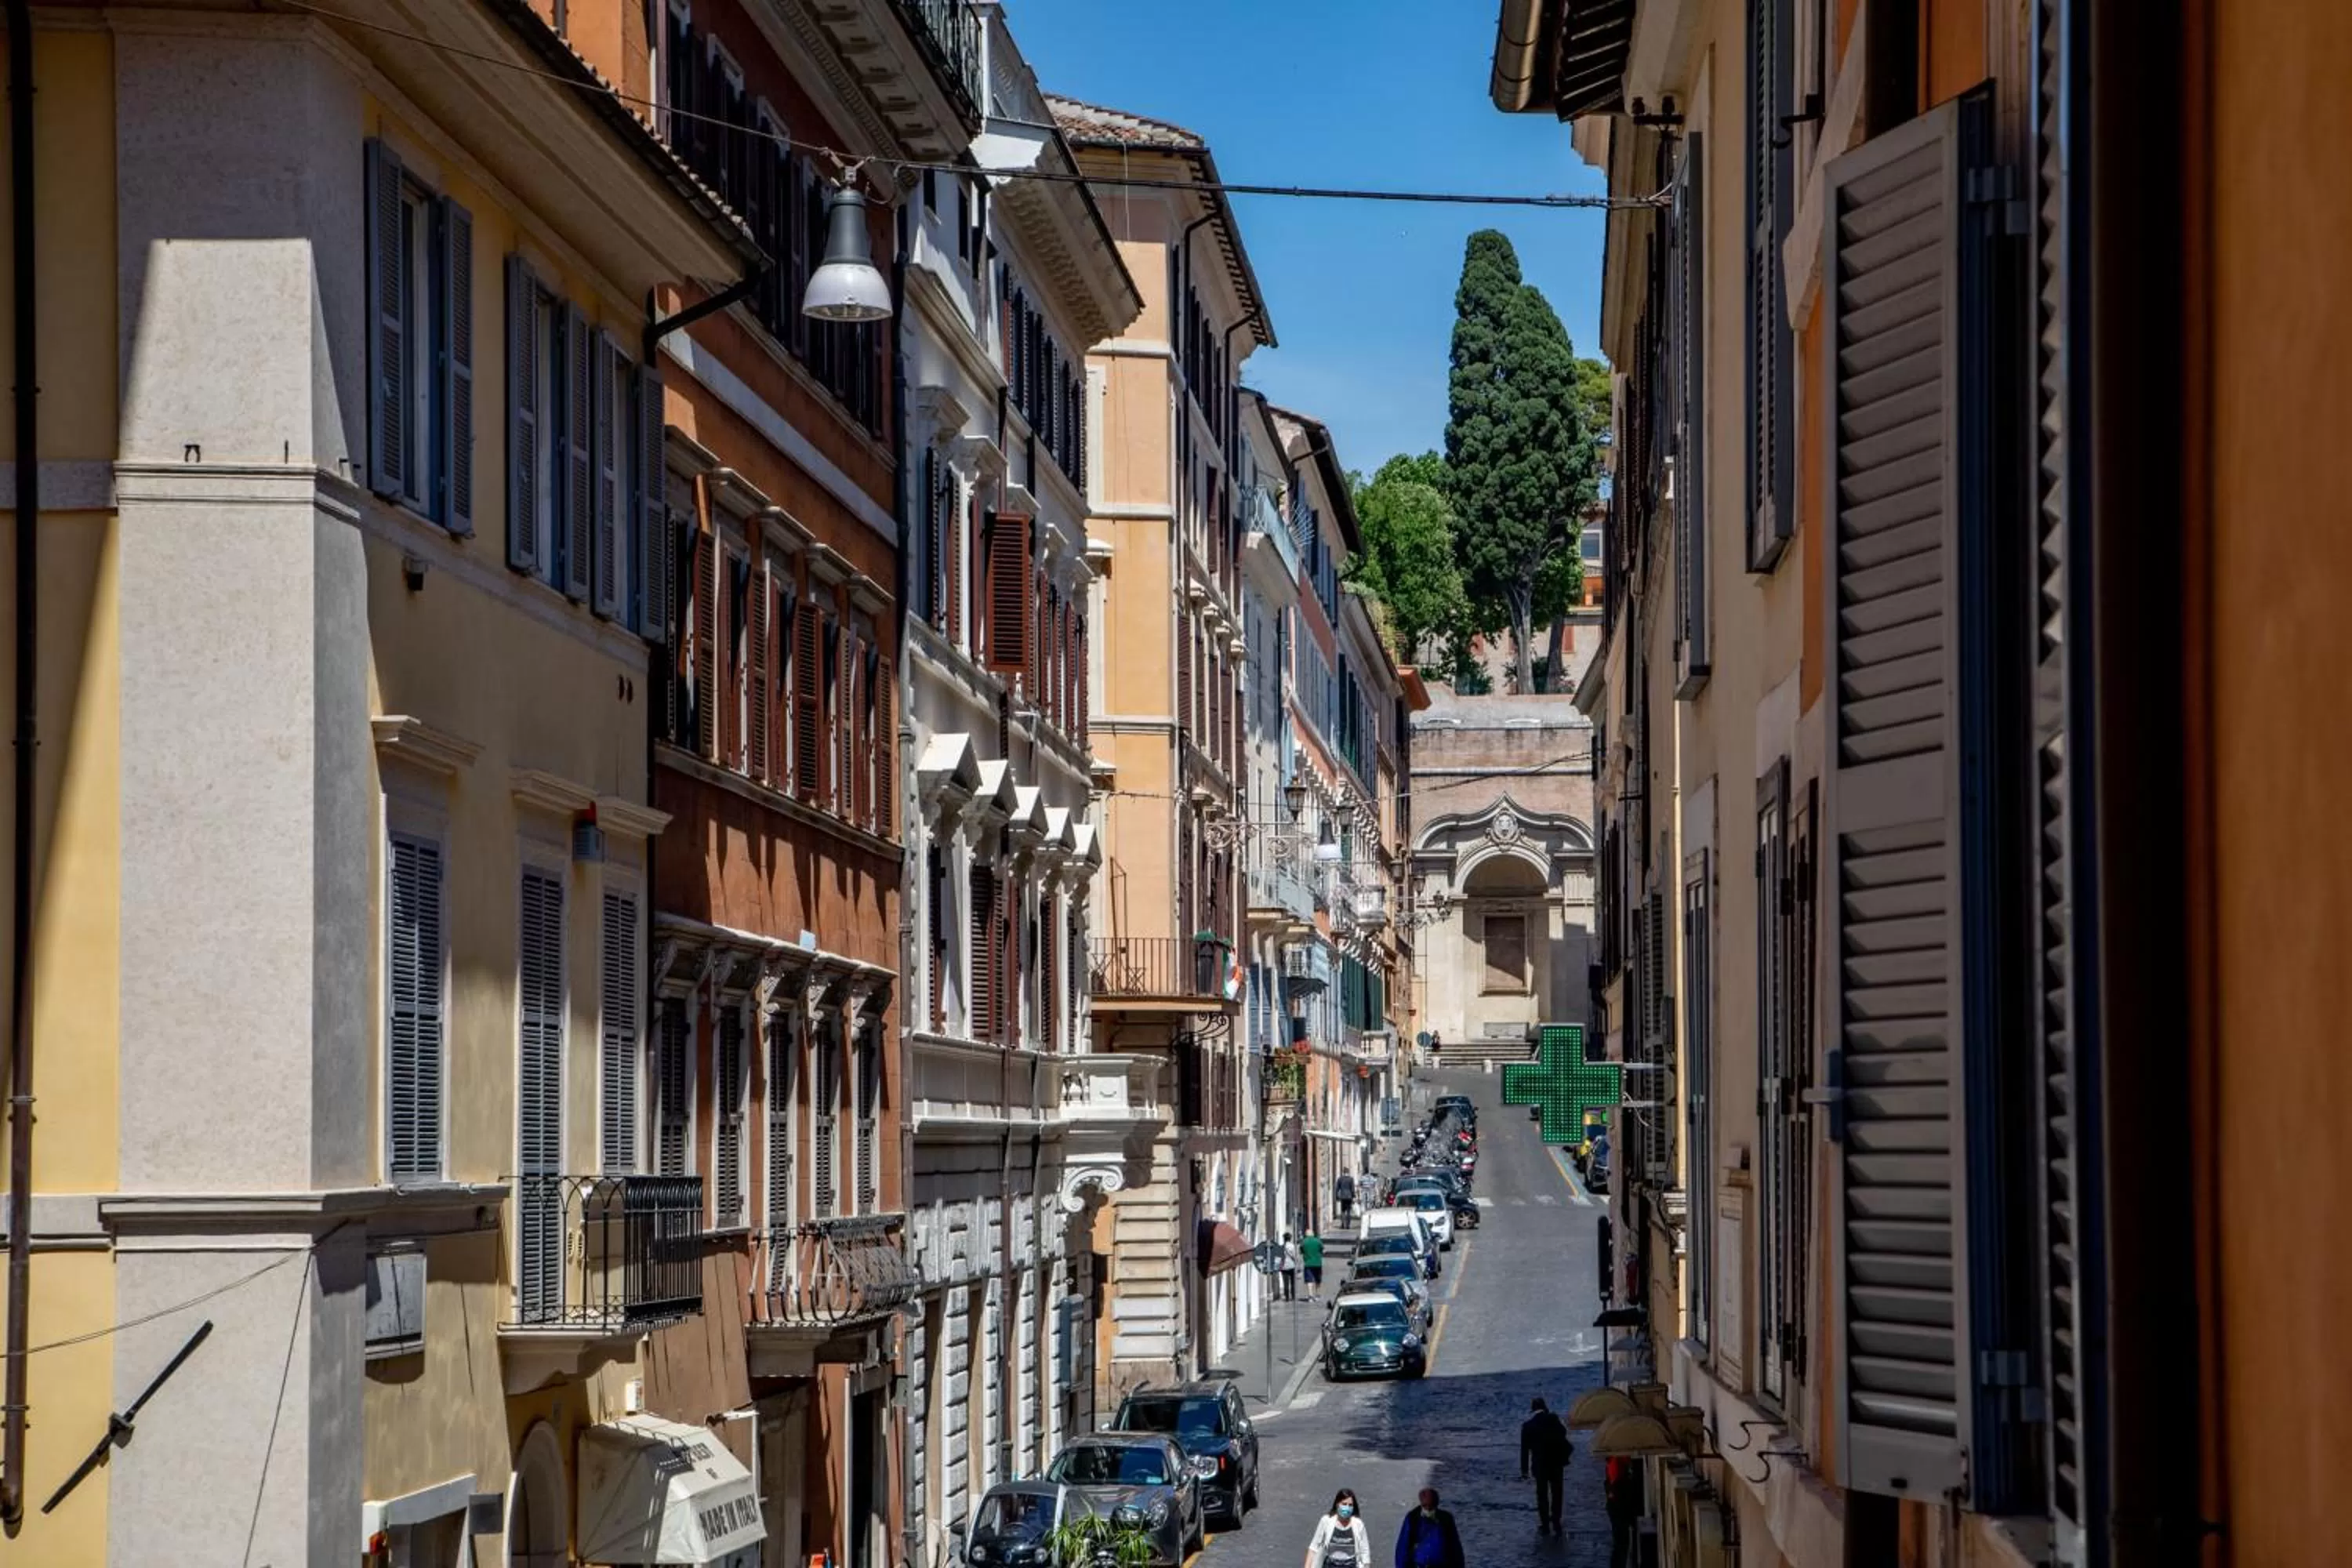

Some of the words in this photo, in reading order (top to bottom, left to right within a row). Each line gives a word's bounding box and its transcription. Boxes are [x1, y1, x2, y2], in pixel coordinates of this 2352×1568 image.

[699, 1504, 728, 1542] MADE
[724, 1501, 739, 1532] IN
[735, 1493, 758, 1528] ITALY
